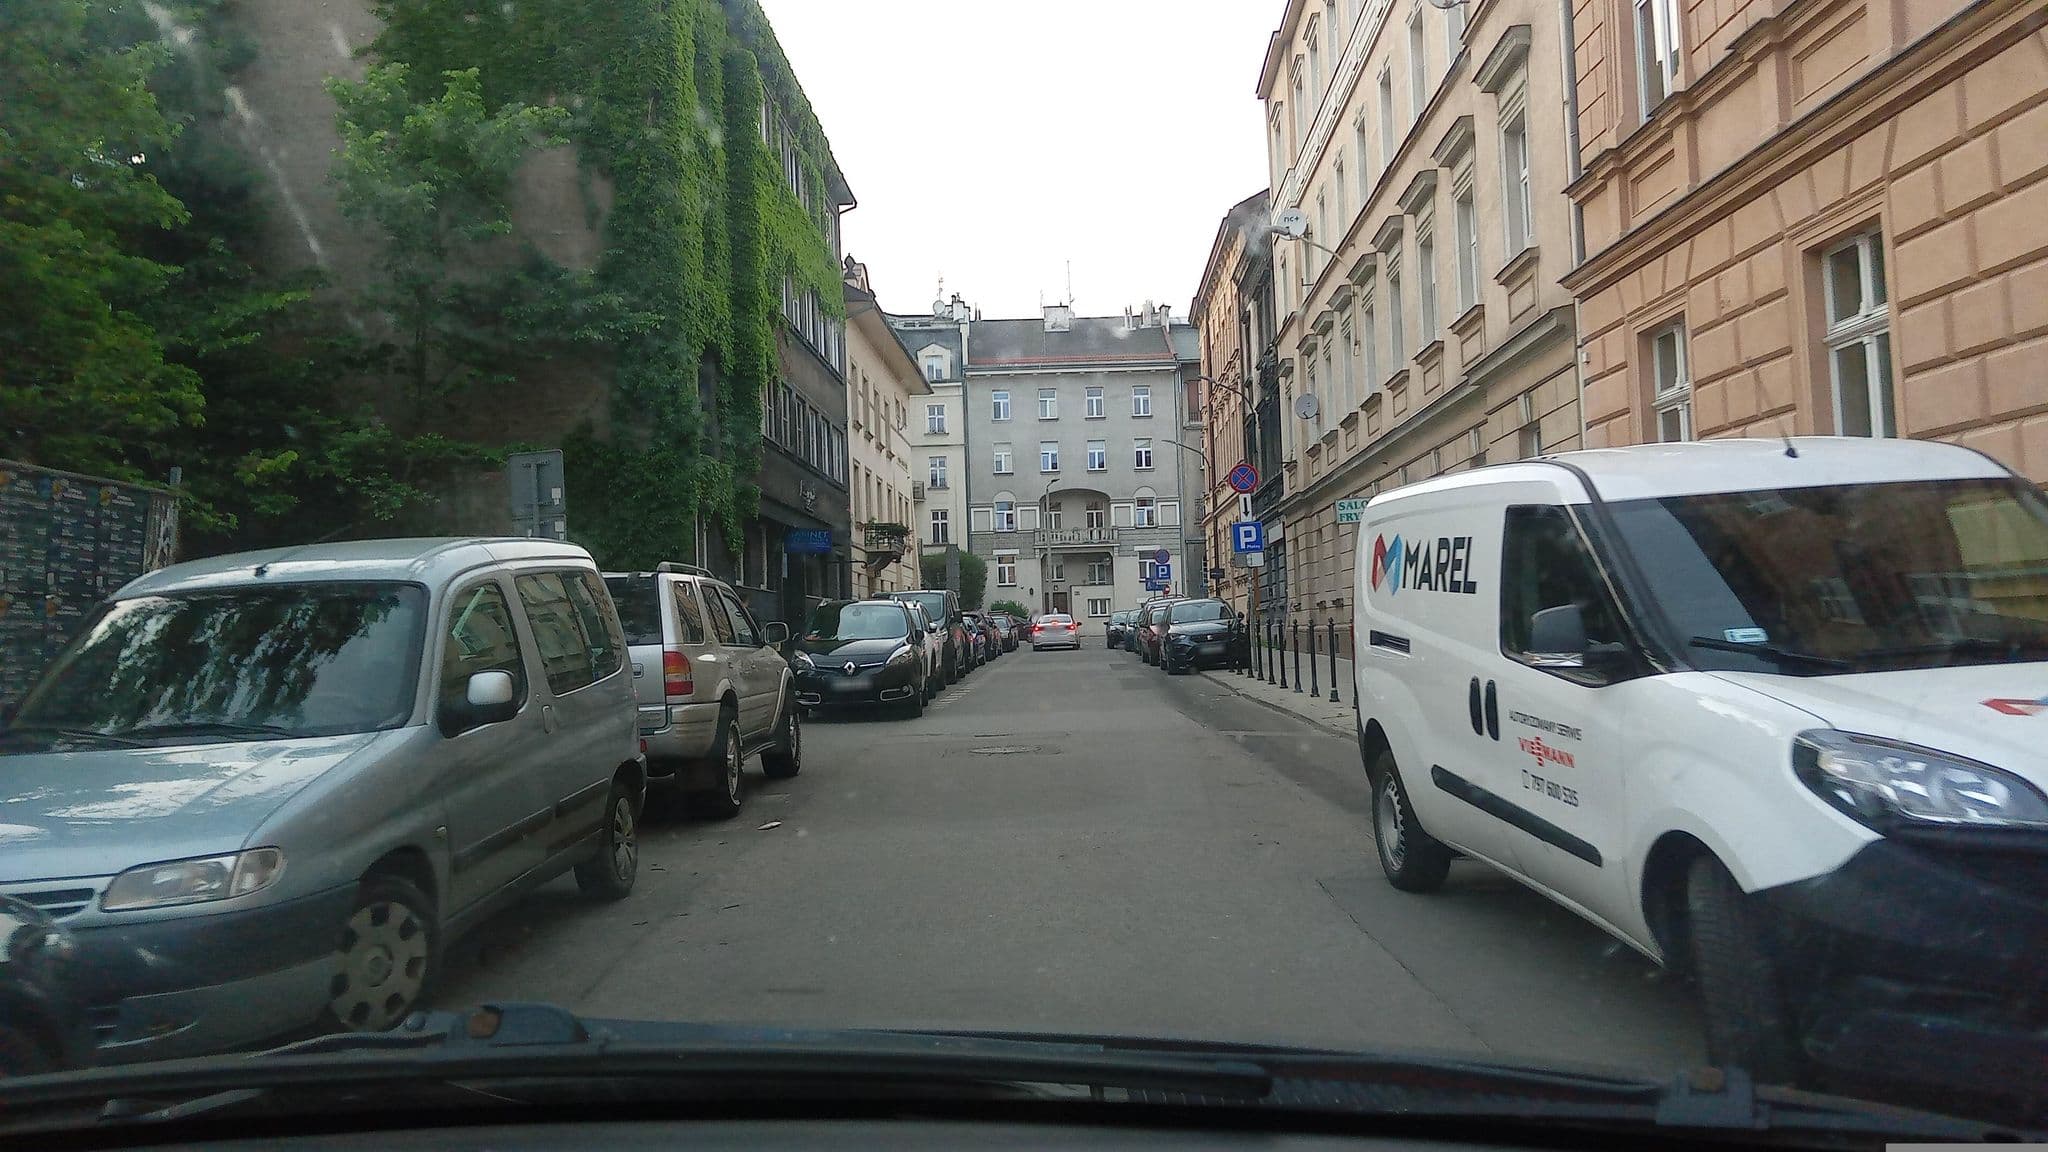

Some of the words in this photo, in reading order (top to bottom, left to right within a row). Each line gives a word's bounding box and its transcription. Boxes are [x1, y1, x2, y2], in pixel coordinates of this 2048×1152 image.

[1339, 512, 1363, 522] FRY
[1239, 526, 1257, 549] P
[1158, 566, 1168, 578] P
[1402, 536, 1477, 594] MAREL
